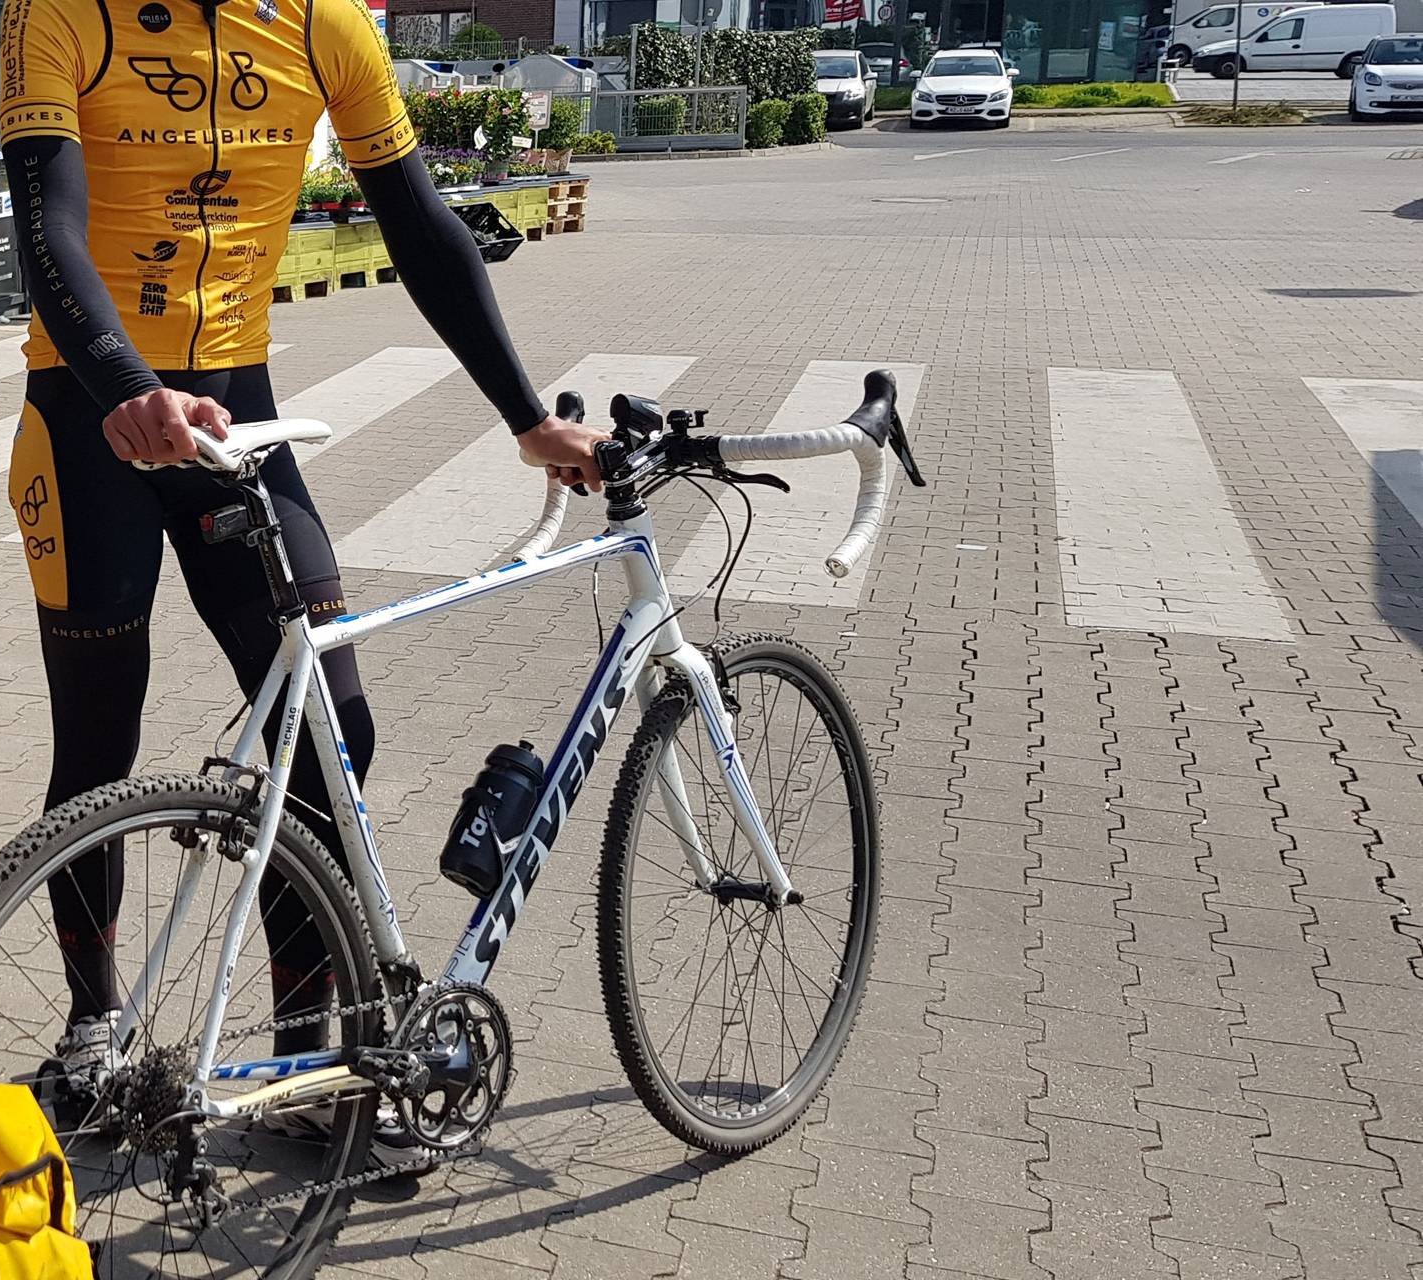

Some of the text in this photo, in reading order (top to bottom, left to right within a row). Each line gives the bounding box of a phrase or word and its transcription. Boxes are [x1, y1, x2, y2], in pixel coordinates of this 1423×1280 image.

[117, 128, 294, 145] ANGELBIKES
[25, 155, 65, 292] FAHRRADBOTE
[164, 209, 238, 224] Landesdrektion
[141, 282, 168, 295] ZERO
[61, 293, 88, 325] IHR
[138, 304, 167, 317] SHIT
[87, 330, 125, 361] ROSE
[50, 615, 146, 640] ANGELBIKES
[475, 667, 630, 970] STEVENS
